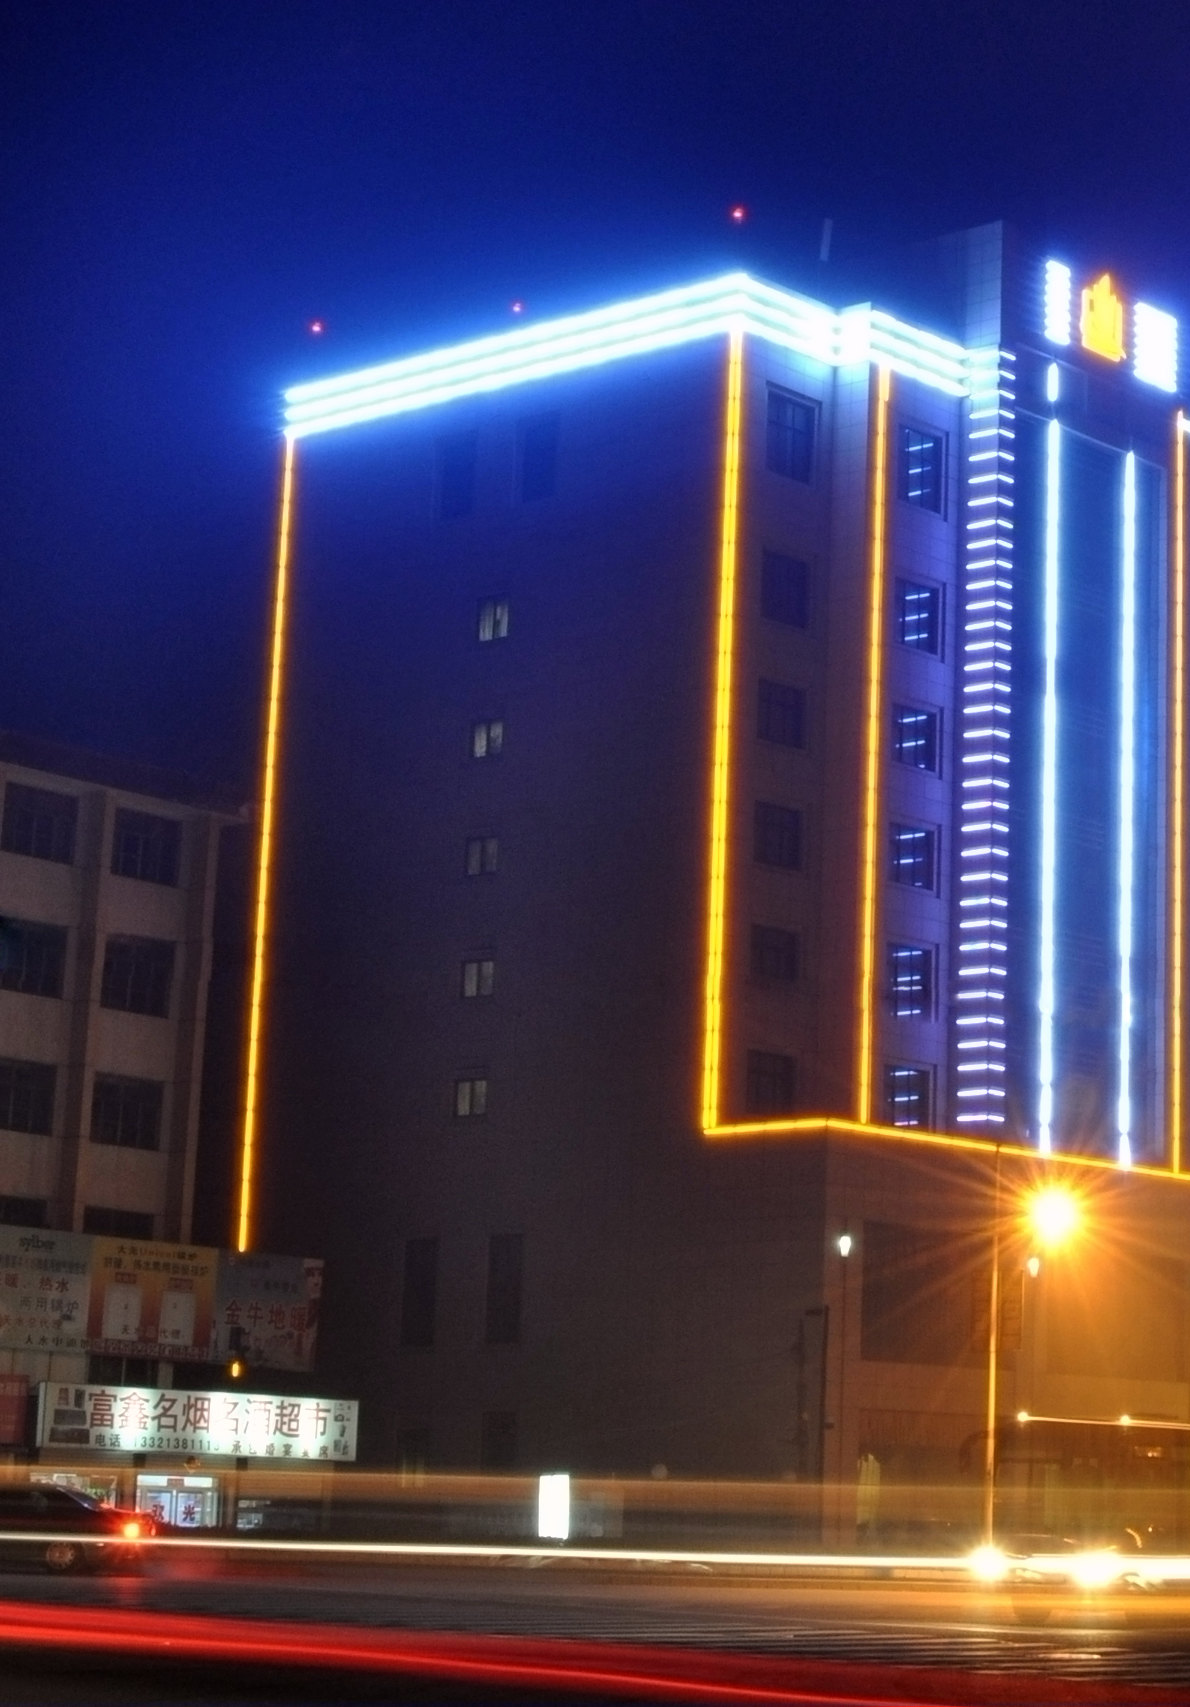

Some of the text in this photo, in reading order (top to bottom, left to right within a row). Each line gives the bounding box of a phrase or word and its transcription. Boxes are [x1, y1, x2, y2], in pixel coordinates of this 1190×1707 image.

[88, 1390, 332, 1439] 富鑫名烟名酒超市
